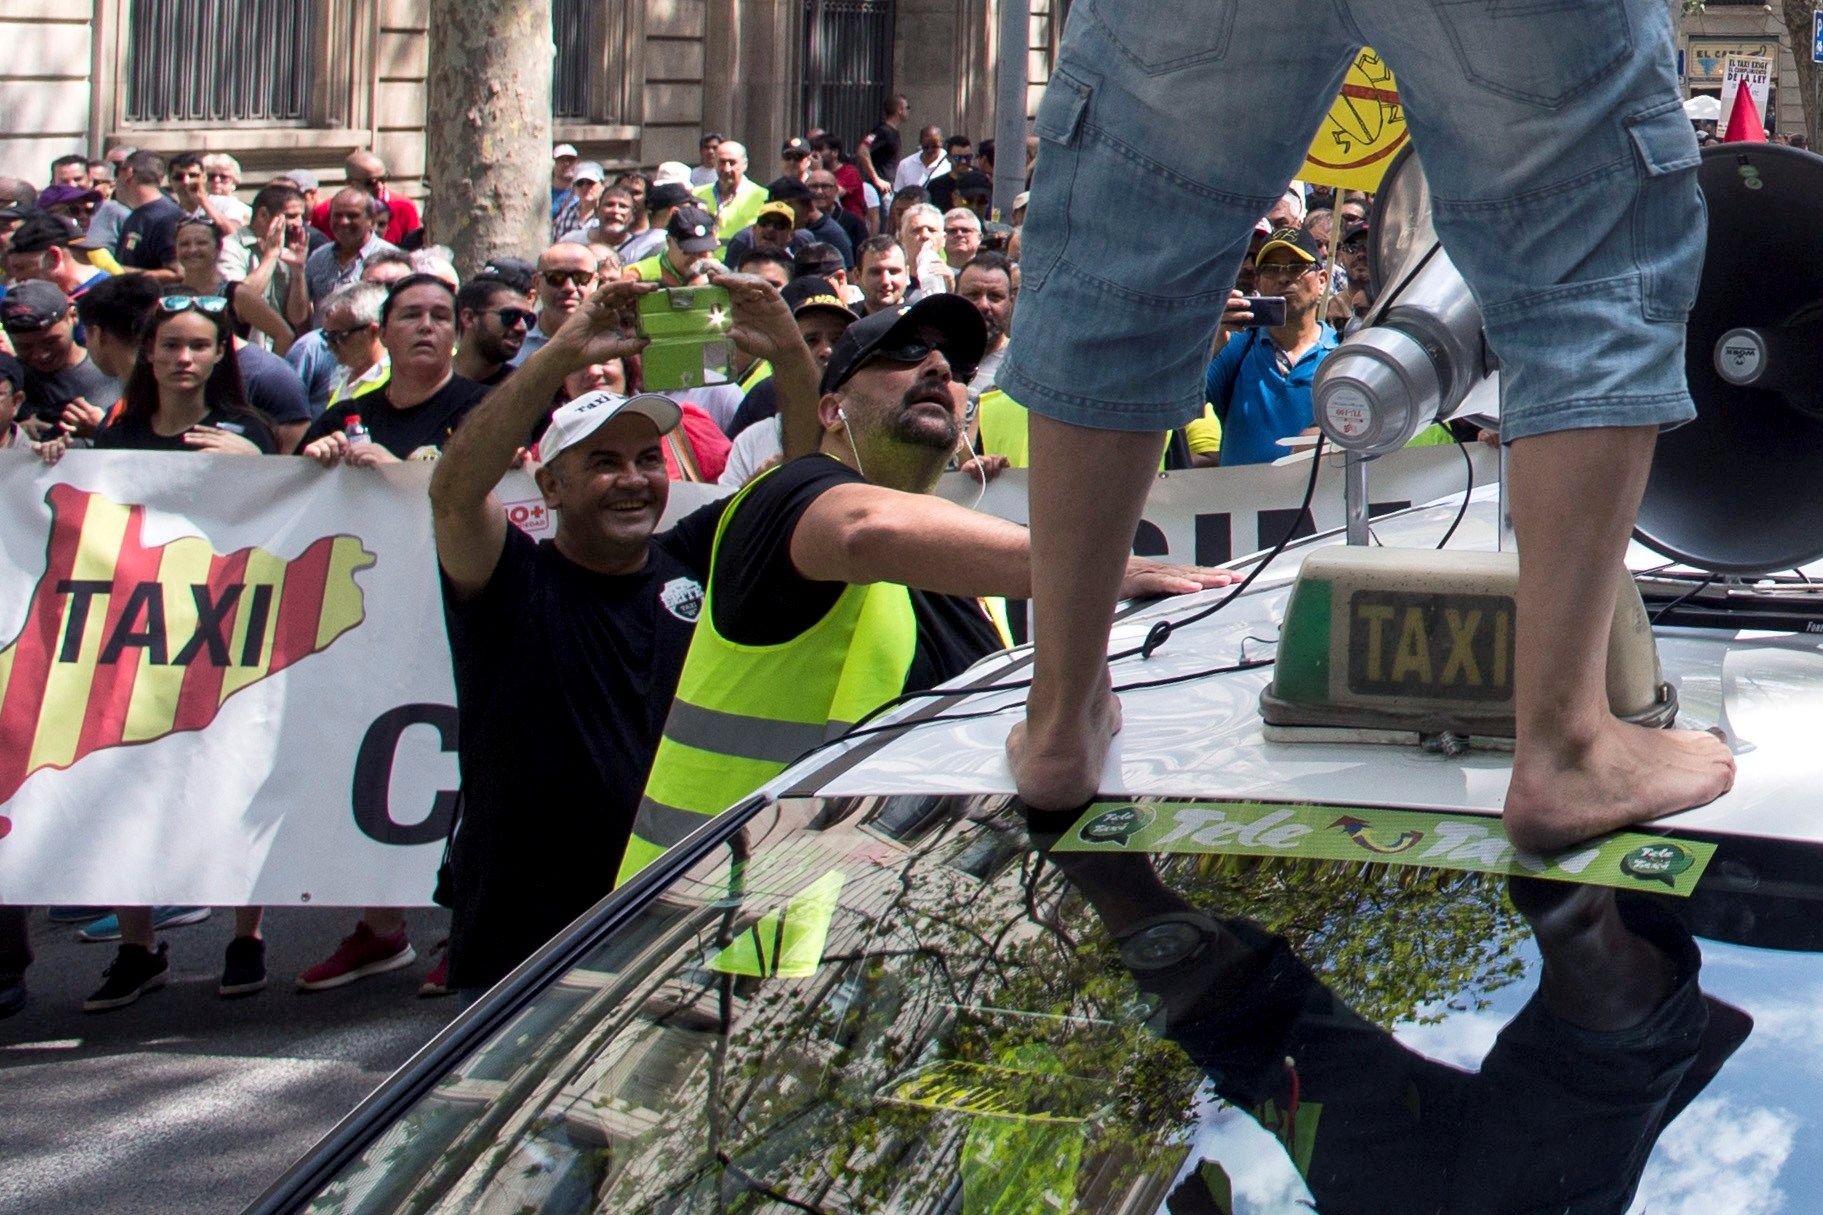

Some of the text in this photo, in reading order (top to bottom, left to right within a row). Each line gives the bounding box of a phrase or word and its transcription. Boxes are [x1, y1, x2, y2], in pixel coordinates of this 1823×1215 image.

[1817, 19, 1823, 37] P
[1696, 50, 1711, 59] EL
[1738, 60, 1750, 68] TAXI
[1727, 73, 1767, 84] DE LA LEY
[56, 579, 274, 668] TAXI
[1356, 603, 1510, 688] TAXI
[1151, 808, 1314, 850] Tele
